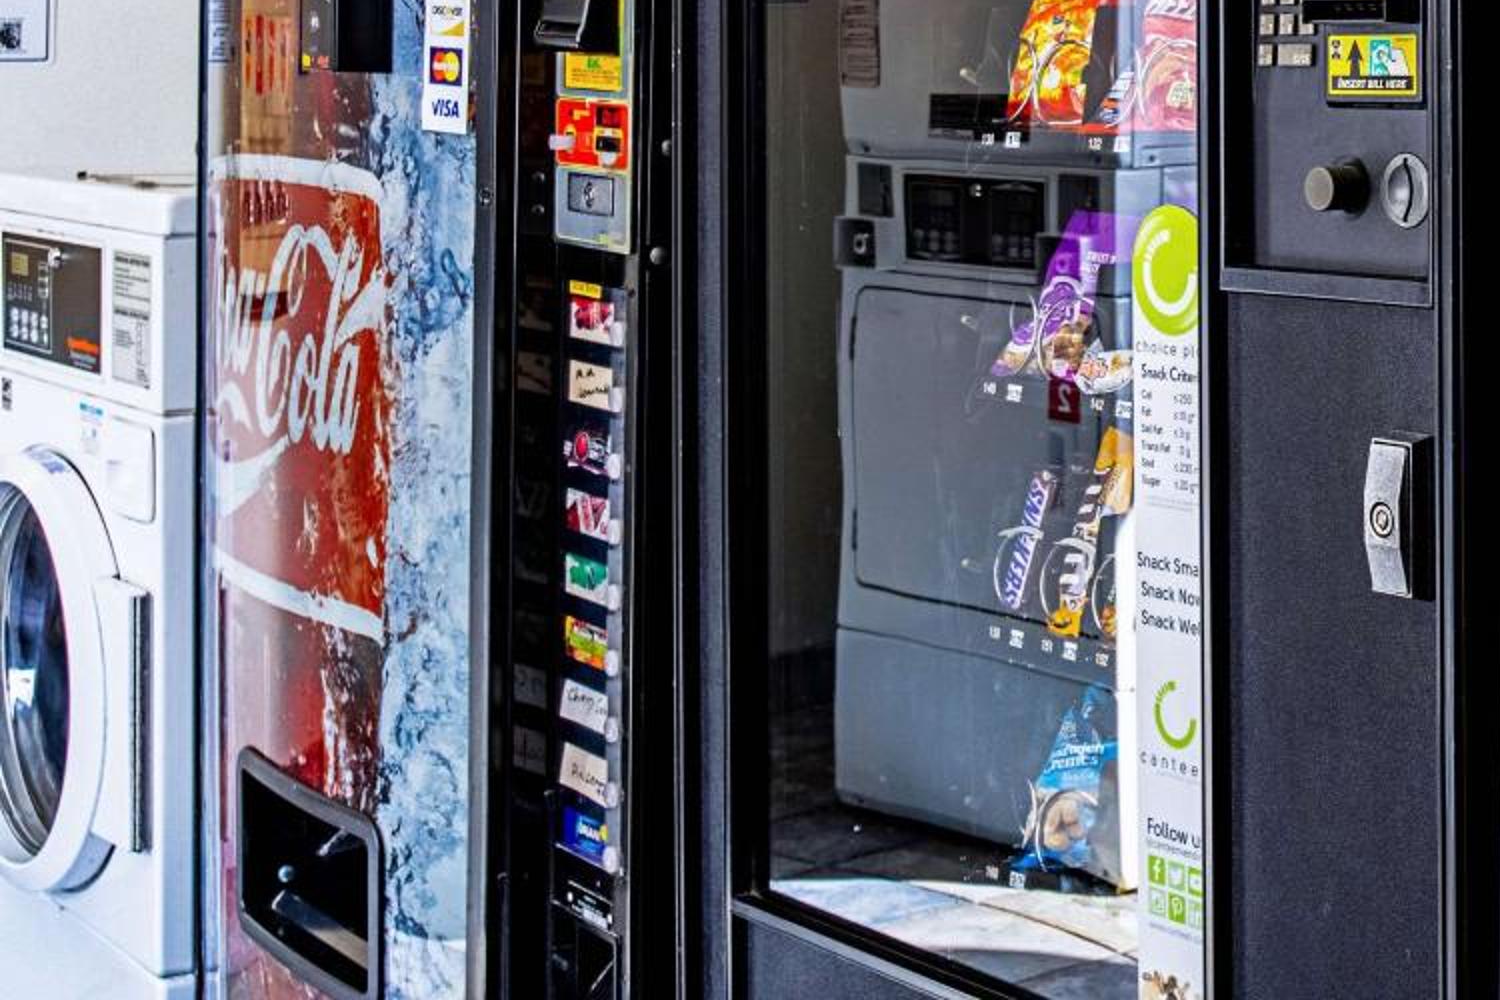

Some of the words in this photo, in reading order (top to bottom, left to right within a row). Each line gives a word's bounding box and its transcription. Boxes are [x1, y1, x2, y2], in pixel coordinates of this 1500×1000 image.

[1368, 79, 1383, 88] BILL
[1384, 79, 1407, 88] HERE
[431, 98, 460, 119] VISA
[1136, 341, 1177, 356] choice
[1183, 345, 1199, 358] pl
[1141, 363, 1166, 380] Snack
[1001, 476, 1049, 610] SNIKERS
[1138, 552, 1171, 572] Snack
[1141, 581, 1175, 601] Snack
[1141, 610, 1175, 630] Snack
[1147, 818, 1189, 845] Follow
